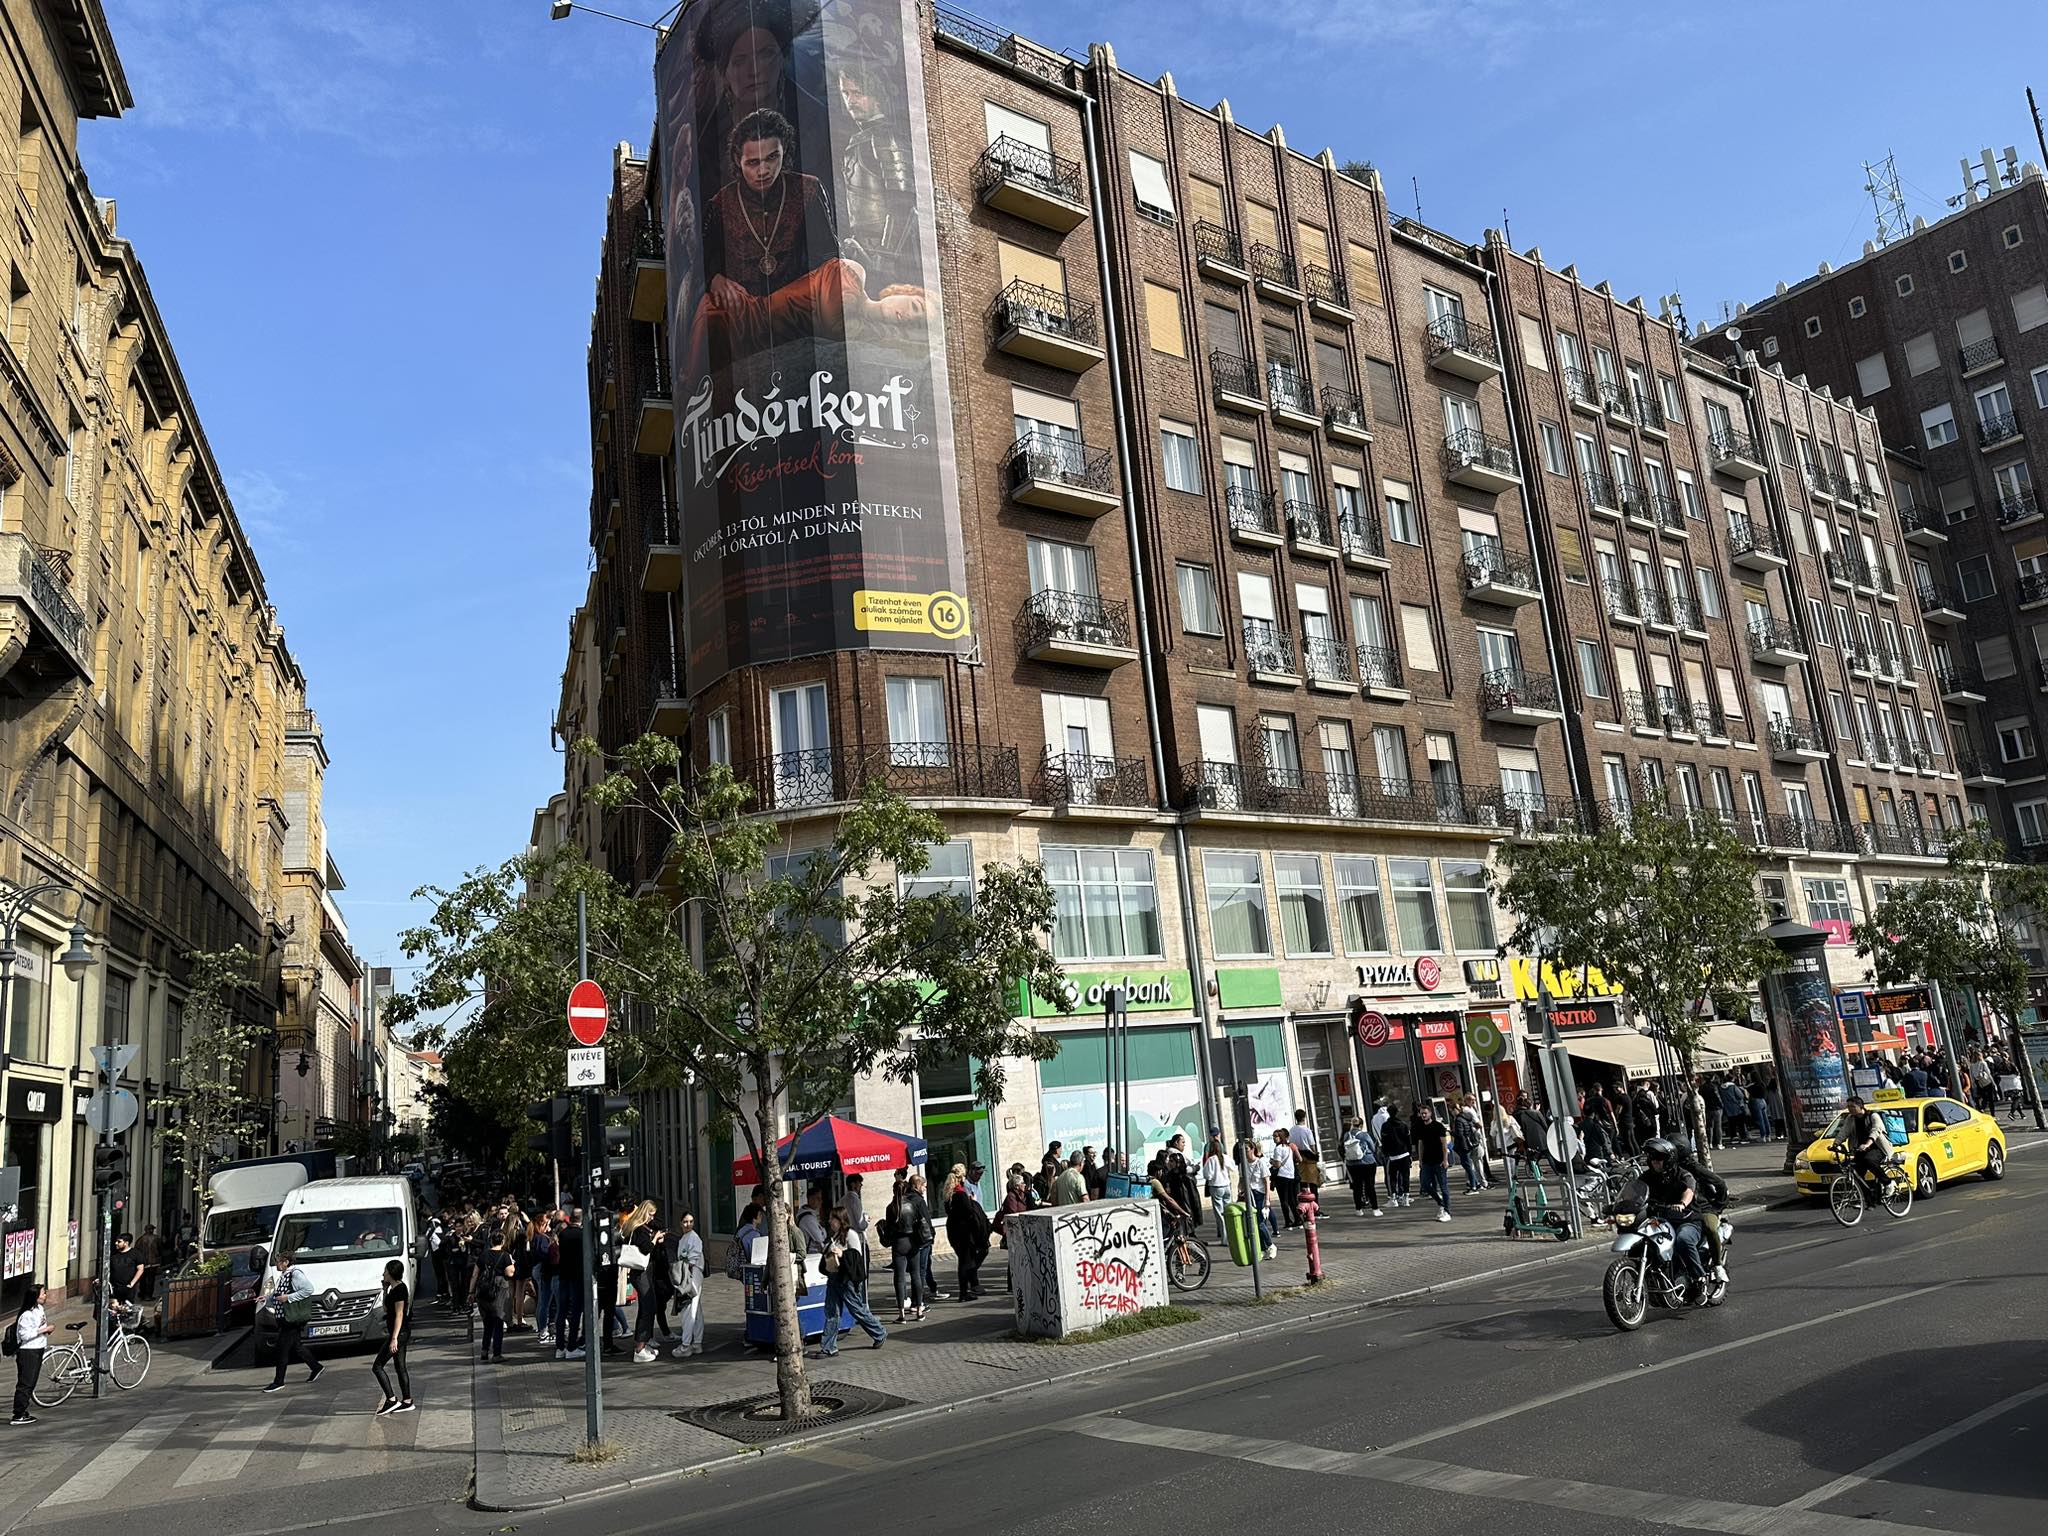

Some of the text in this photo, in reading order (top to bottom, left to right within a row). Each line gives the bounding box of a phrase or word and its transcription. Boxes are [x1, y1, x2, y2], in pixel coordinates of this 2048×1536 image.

[827, 439, 864, 466] kora
[726, 516, 768, 538] 13-TÓL
[772, 503, 836, 526] MINDEN
[842, 500, 923, 520] PÉNTEKEN
[718, 519, 863, 559] 21 ÓRÁTÓL A DUNÁN
[868, 597, 922, 607] Tizenhat éven
[888, 607, 922, 616] számára
[938, 607, 955, 623] 16
[894, 616, 923, 625] ajánlott
[15, 953, 34, 971] ATEDRA
[1360, 964, 1416, 986] PIZZA
[1548, 1006, 1597, 1026] BISZTRÓ
[1425, 1022, 1449, 1034] PIZZA
[570, 1050, 602, 1061] KIVÉVE
[1732, 1056, 1750, 1064] KAKAS
[1631, 1068, 1651, 1077] KAKAS
[800, 1160, 832, 1171] TOURIST
[843, 1154, 891, 1166] INFORMATION
